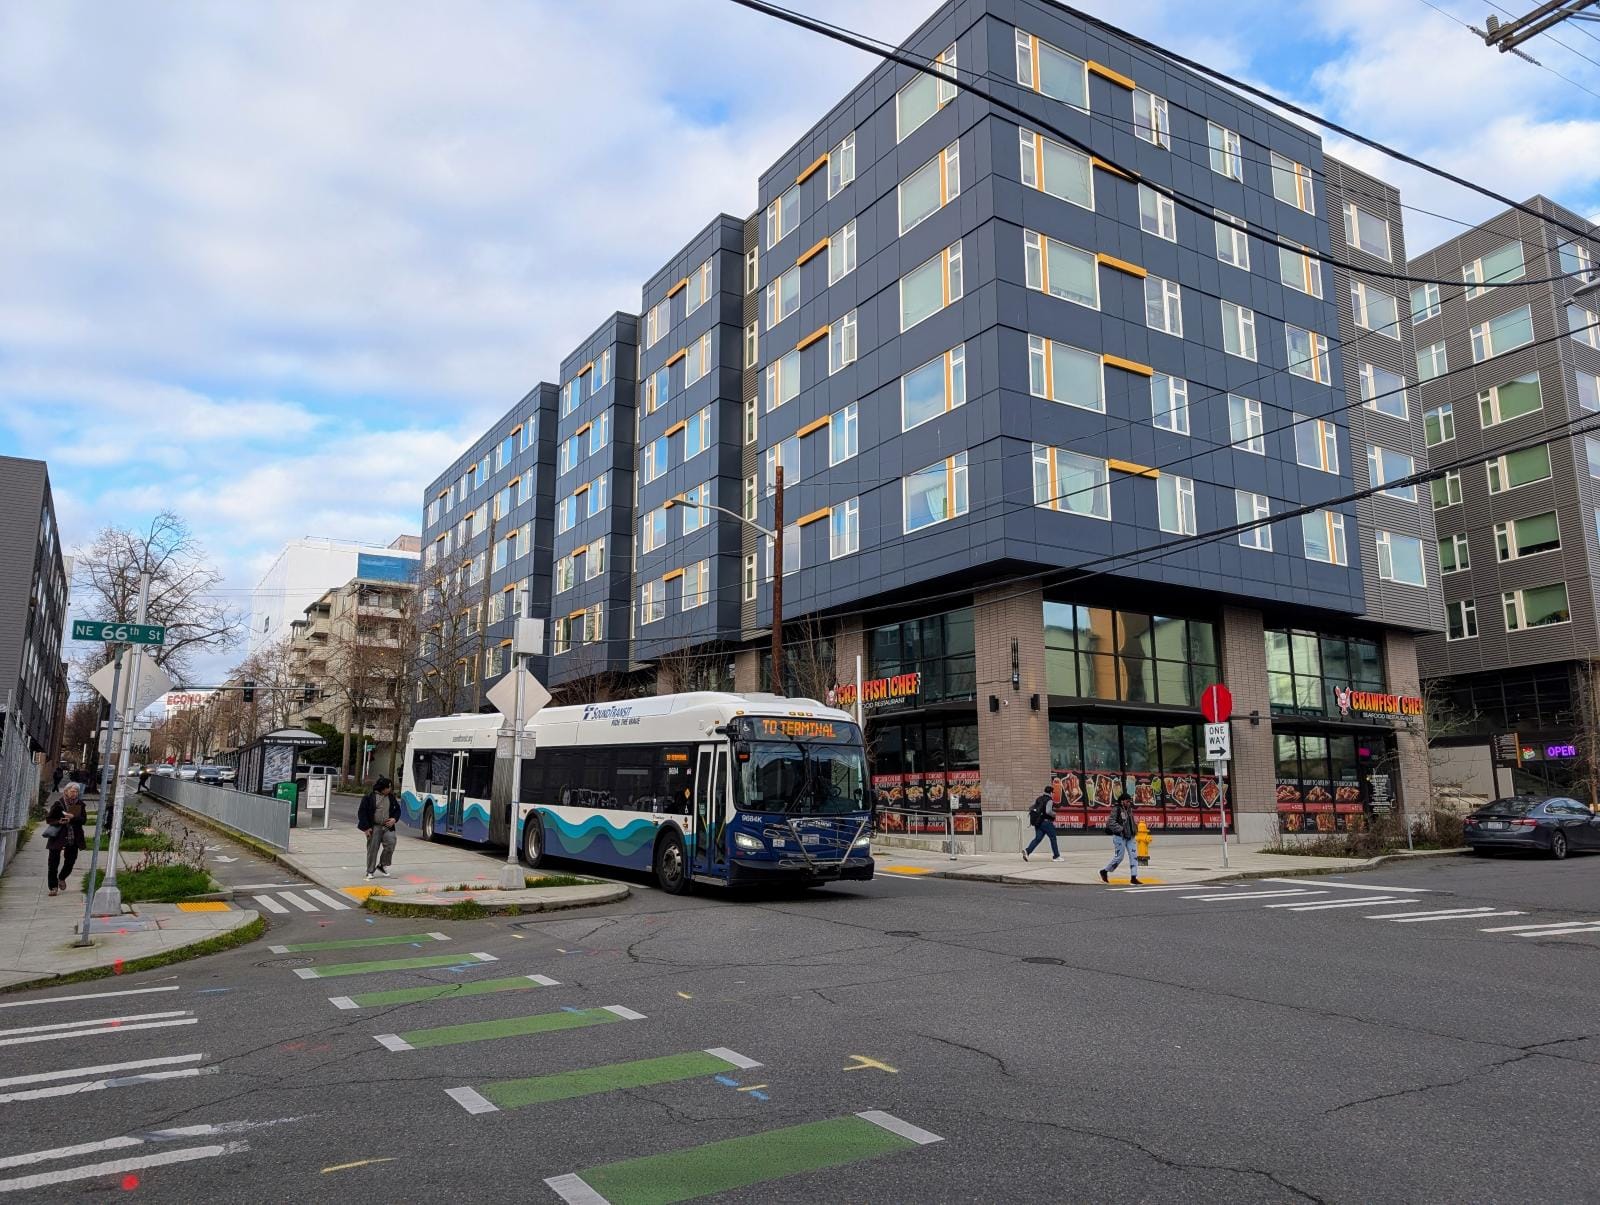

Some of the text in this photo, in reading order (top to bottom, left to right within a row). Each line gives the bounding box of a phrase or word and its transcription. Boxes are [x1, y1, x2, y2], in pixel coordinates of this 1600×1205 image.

[75, 624, 161, 640] NE 66th St
[890, 672, 918, 697] CHEF
[1352, 691, 1399, 713] CRAWFISH
[763, 720, 836, 738] TO TERMINAL
[1209, 726, 1224, 735] ONE
[1209, 736, 1225, 745] WAY
[1547, 745, 1576, 758] OPEN
